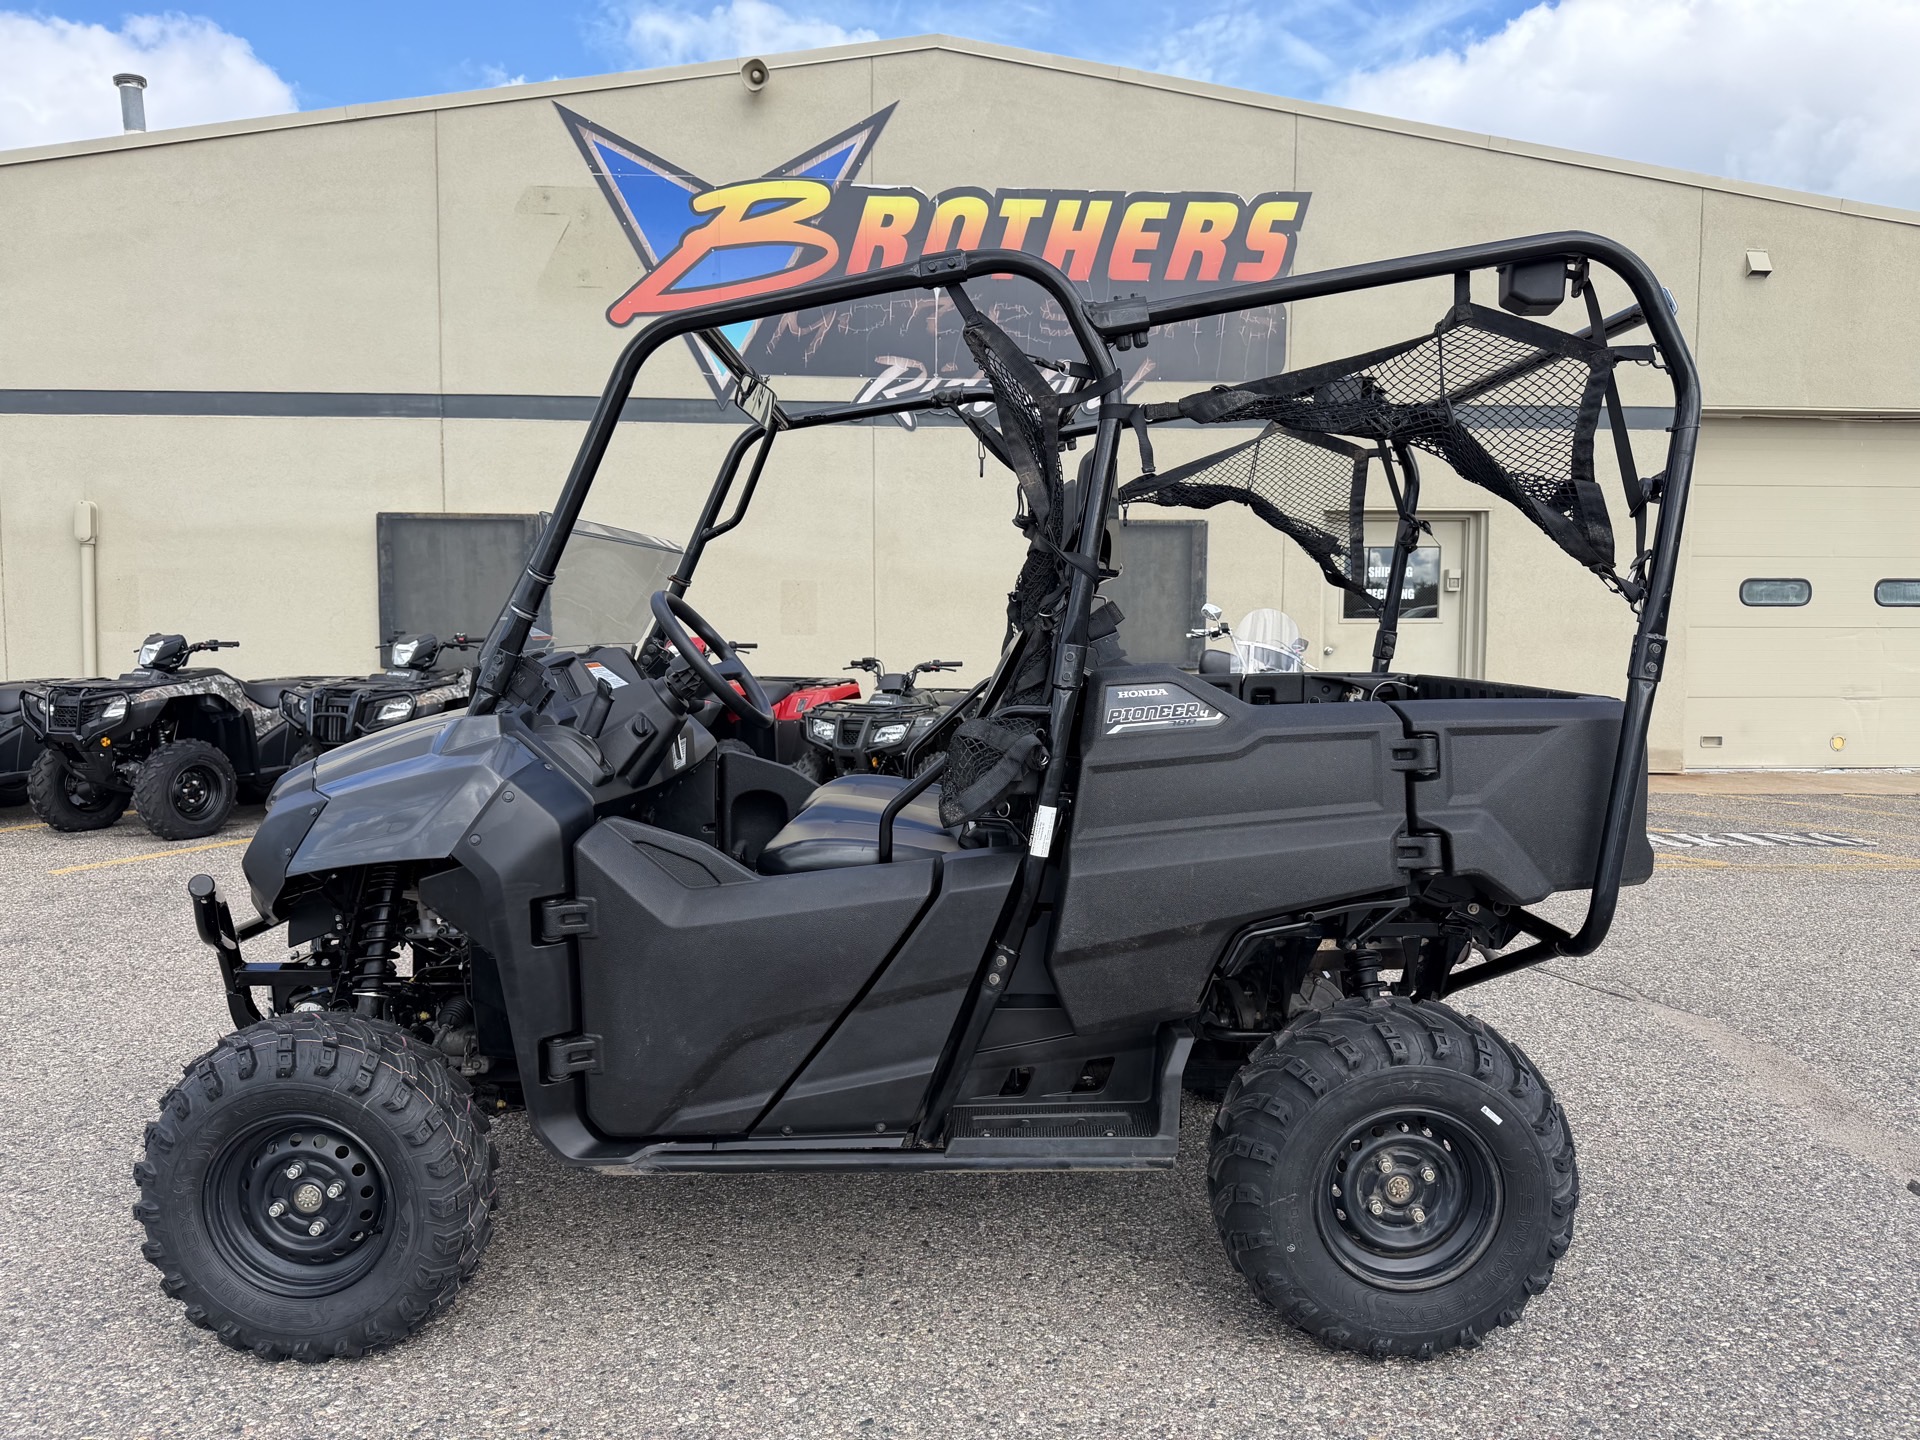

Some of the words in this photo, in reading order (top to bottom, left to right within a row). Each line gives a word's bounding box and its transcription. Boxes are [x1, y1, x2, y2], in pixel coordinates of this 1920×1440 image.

[606, 180, 1300, 327] BROTHERS
[1117, 688, 1169, 699] HONDA
[1107, 702, 1200, 724] PIONEER
